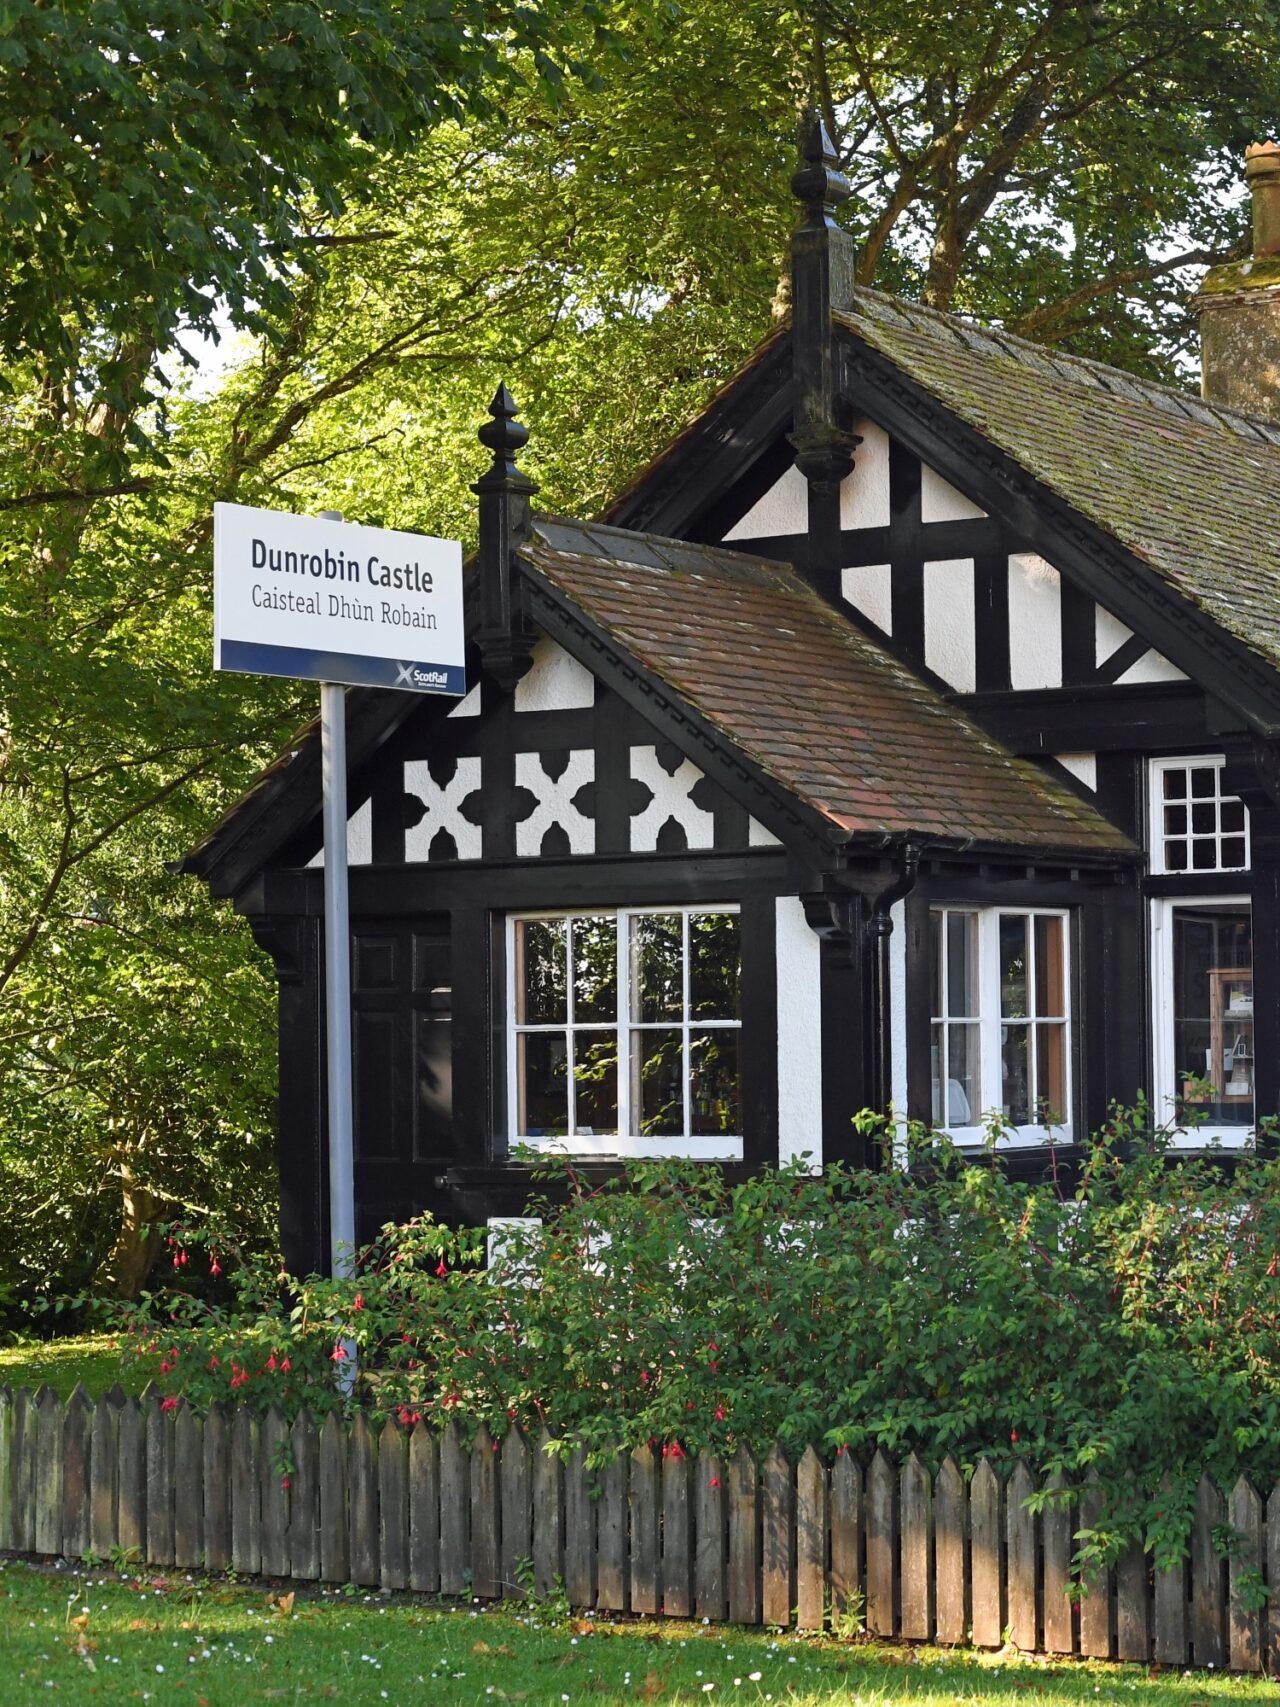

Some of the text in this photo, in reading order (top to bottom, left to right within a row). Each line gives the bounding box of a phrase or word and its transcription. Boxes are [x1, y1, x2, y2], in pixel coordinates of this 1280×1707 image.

[252, 539, 433, 593] Dunrobin Castle
[252, 584, 437, 630] Caisteal Dhùn Robain
[414, 669, 448, 684] ScotRail
